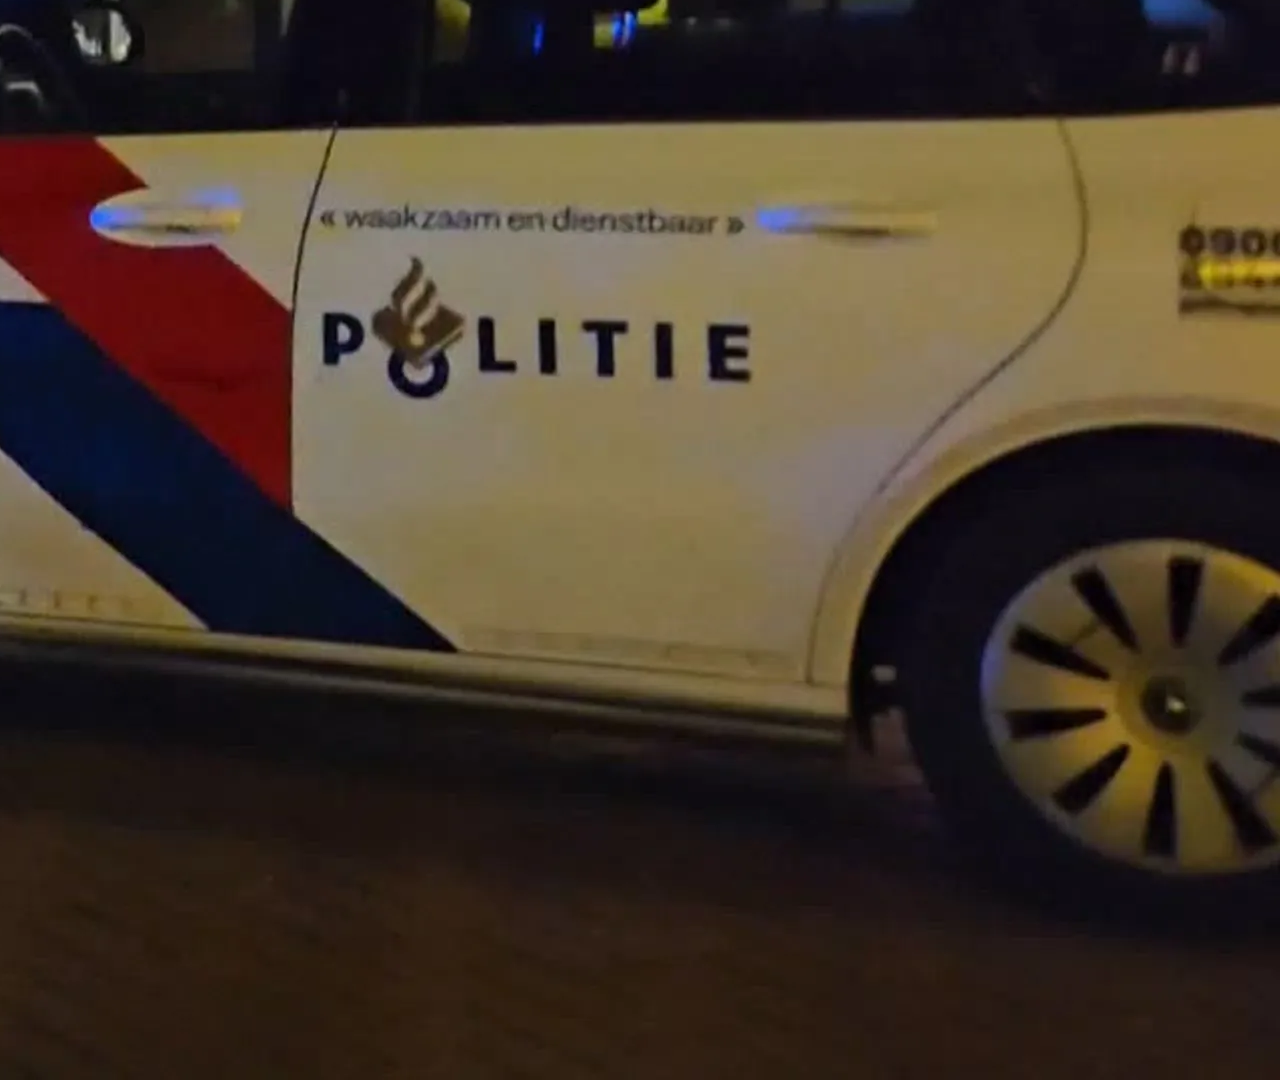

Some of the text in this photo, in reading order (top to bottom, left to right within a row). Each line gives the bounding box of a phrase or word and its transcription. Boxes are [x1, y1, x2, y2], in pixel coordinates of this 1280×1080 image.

[507, 210, 544, 232] en
[552, 204, 718, 235] dienstbaar
[322, 312, 752, 399] POLITIE
